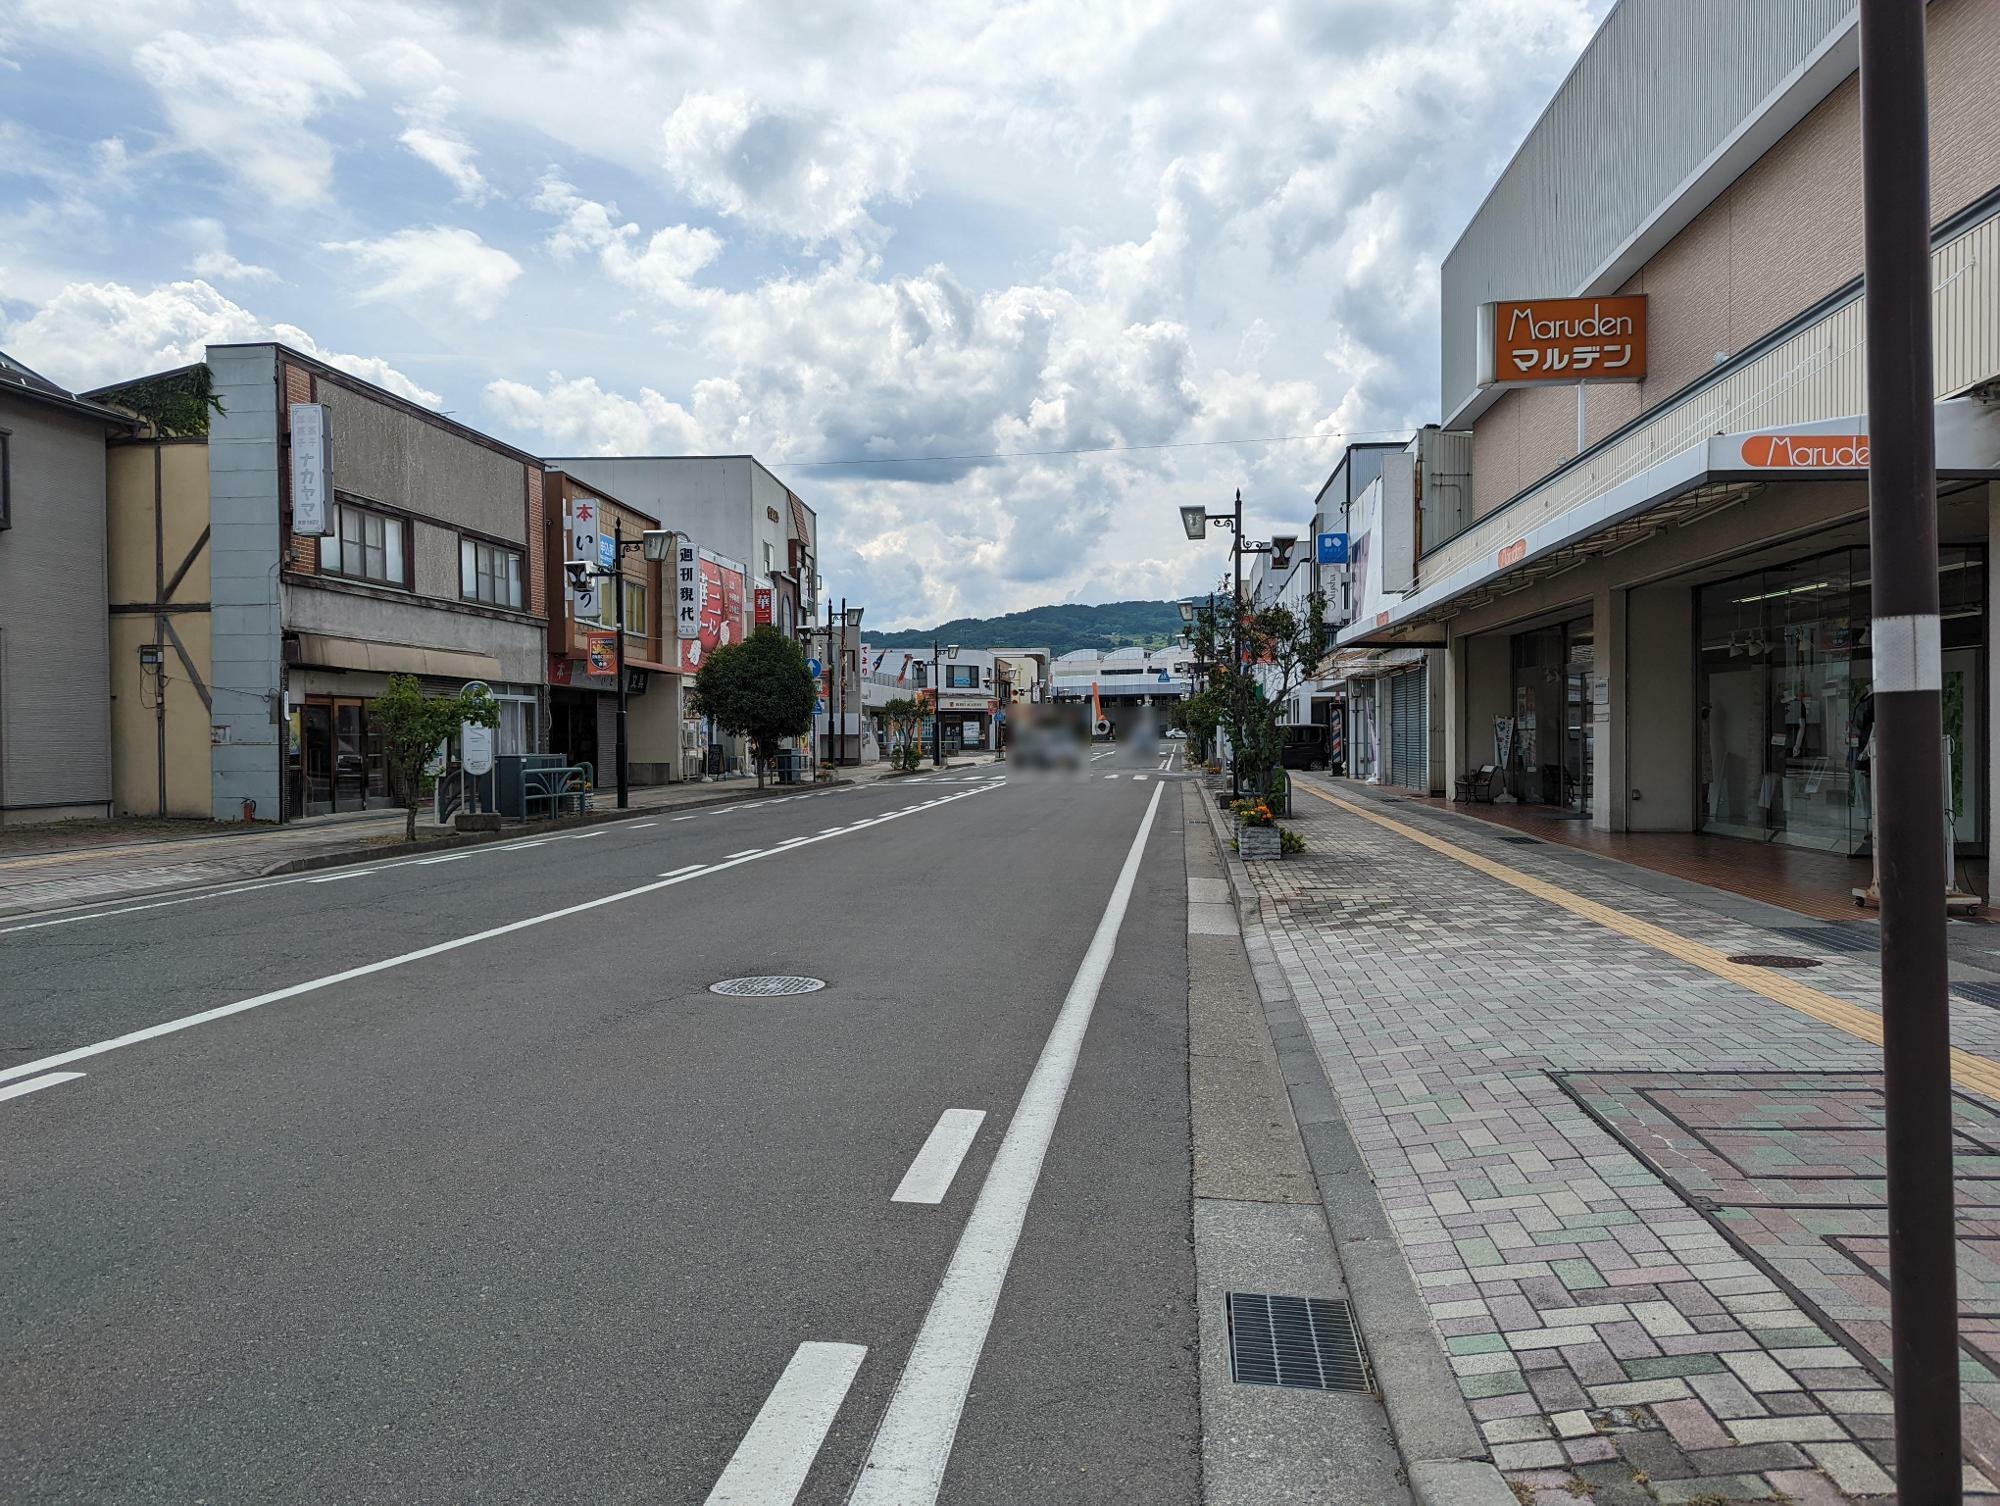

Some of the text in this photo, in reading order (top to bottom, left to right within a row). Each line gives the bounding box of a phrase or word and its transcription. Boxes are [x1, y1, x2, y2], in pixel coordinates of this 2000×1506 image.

[1508, 304, 1632, 341] Maruden
[1512, 344, 1631, 371] マルデン
[1767, 436, 1870, 466] Marude
[300, 453, 315, 517] ナカヤマ
[679, 547, 694, 621] 週刊現代
[700, 618, 719, 636] ーメン
